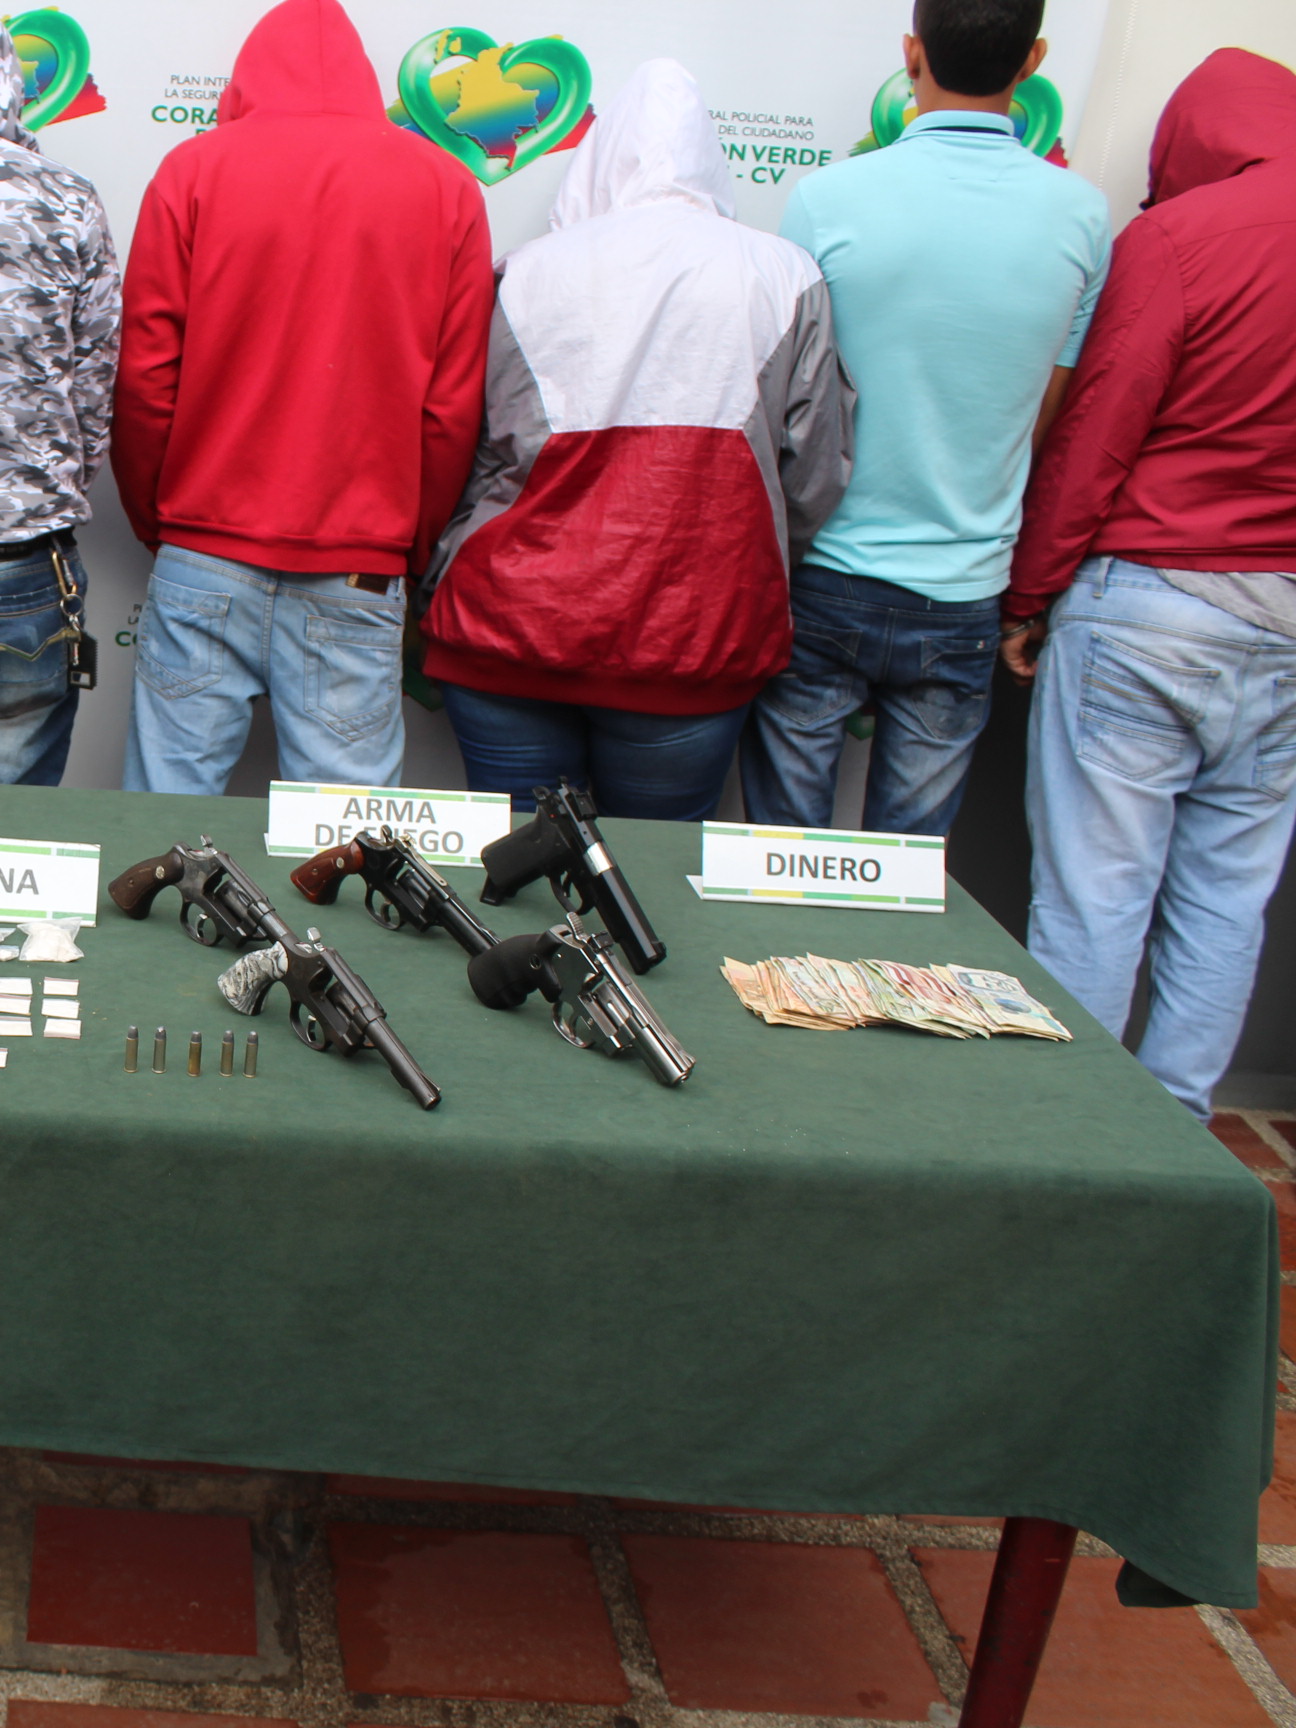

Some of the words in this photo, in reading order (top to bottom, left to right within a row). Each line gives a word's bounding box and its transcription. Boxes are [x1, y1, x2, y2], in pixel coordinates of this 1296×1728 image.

[170, 74, 200, 86] PLAN
[165, 88, 179, 98] LA
[731, 111, 781, 125] POLICIAL
[784, 115, 814, 127] PARA
[718, 124, 739, 135] DEL
[742, 126, 815, 141] CIUDADANO
[752, 144, 832, 167] VERDE
[751, 166, 786, 185] CV
[342, 797, 437, 824] ARMA
[314, 823, 352, 847] DE
[766, 852, 881, 882] DINERO
